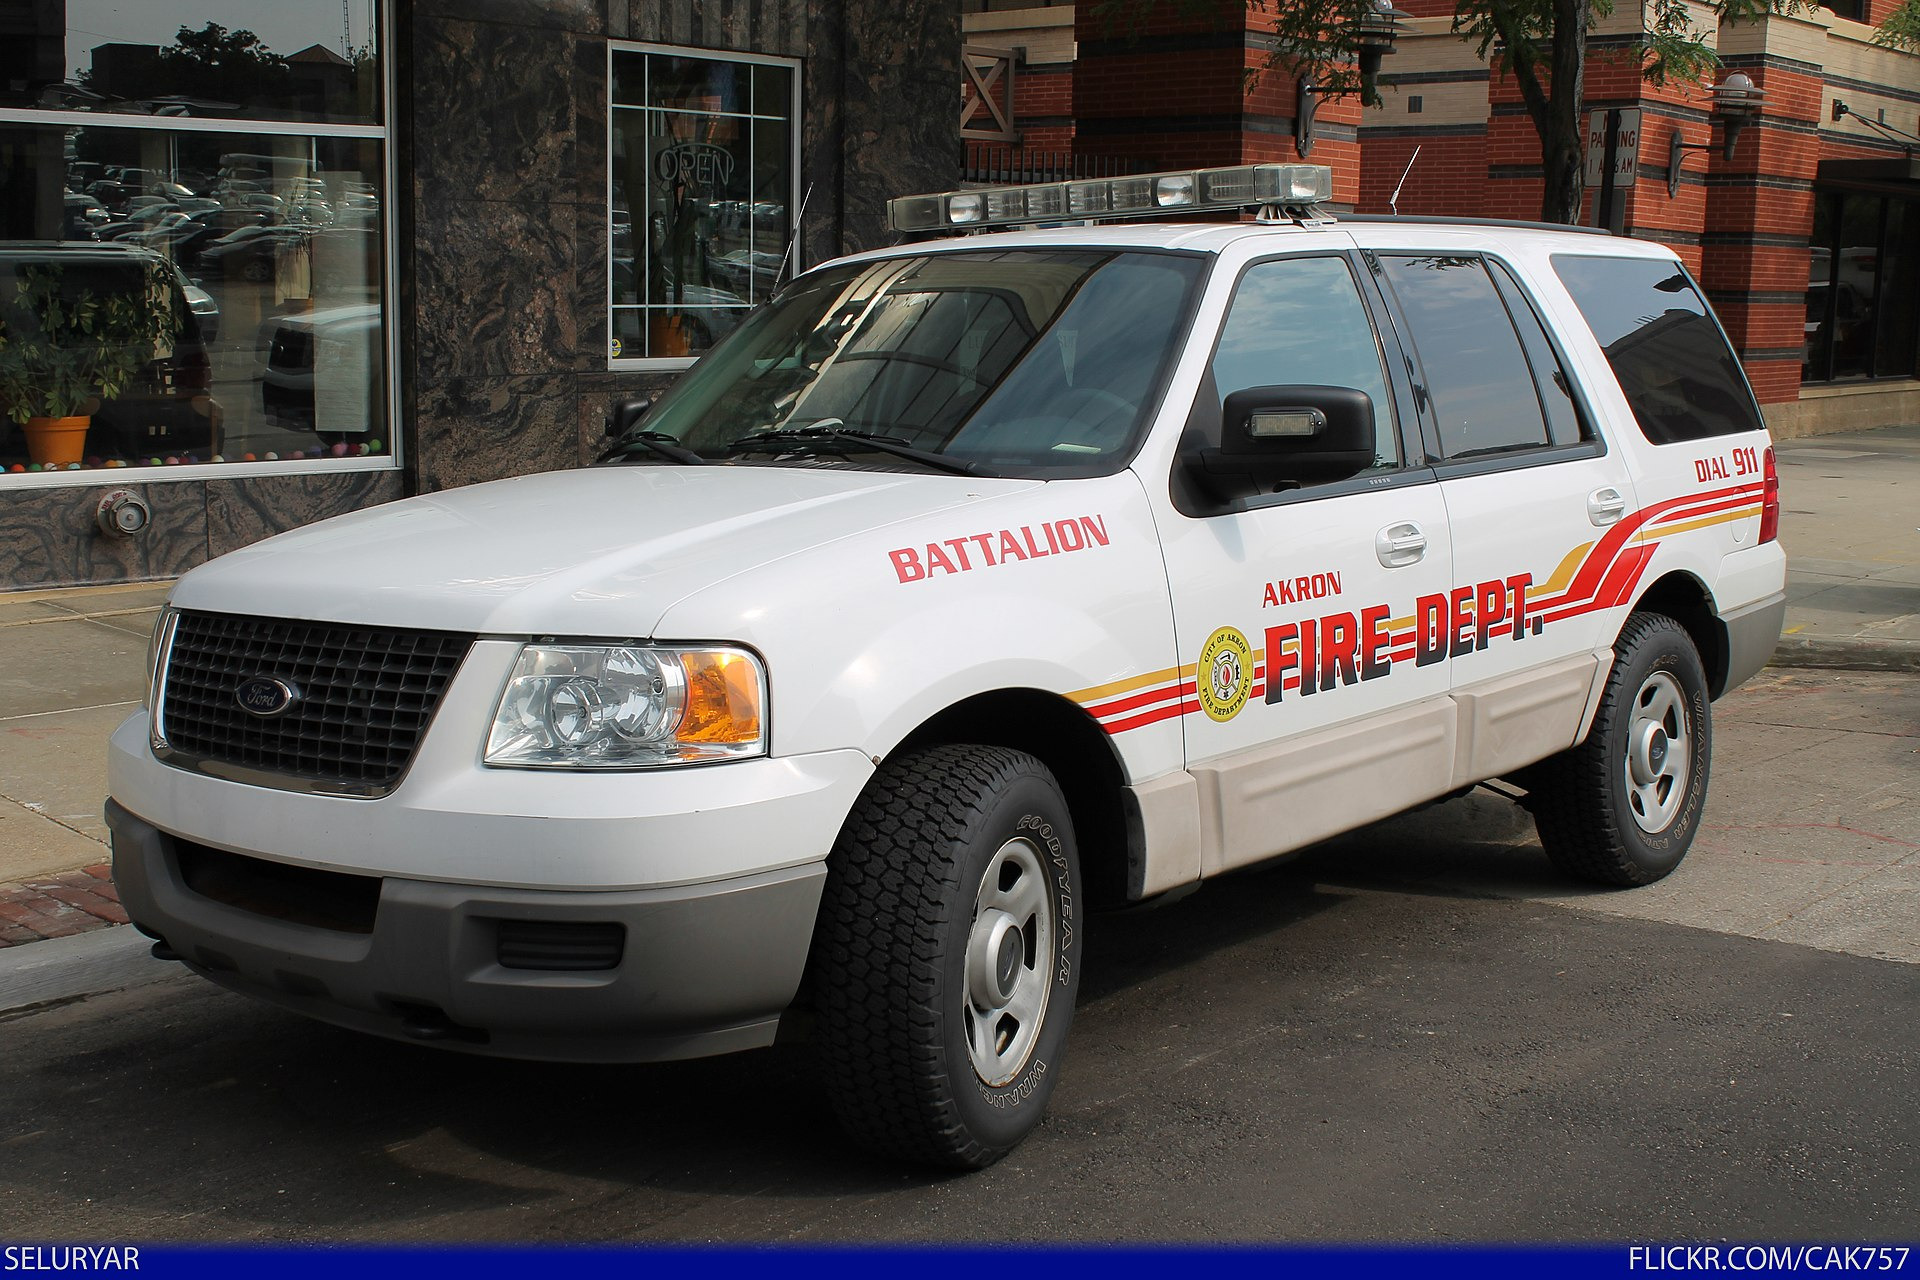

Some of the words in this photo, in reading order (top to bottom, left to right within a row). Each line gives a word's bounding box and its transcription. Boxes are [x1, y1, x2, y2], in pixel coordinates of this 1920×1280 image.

[1590, 130, 1635, 148] PAING
[660, 149, 730, 186] OPEN
[1620, 158, 1633, 174] AM
[1694, 456, 1731, 483] DIAL
[1732, 446, 1759, 476] 911
[888, 513, 1111, 585] BATTALION
[1262, 570, 1343, 609] AKRON
[1204, 641, 1216, 662] CITY
[1216, 633, 1226, 644] OF
[1226, 633, 1247, 654] AKRON
[1264, 603, 1393, 706] FIRE
[1415, 572, 1544, 668] DEPT.
[247, 683, 278, 708] Ford
[1202, 687, 1214, 709] FIRE
[1213, 676, 1249, 715] DEPARTMENT
[1674, 690, 1705, 840] WRANGLER
[1016, 815, 1072, 986] GOODYEAR
[975, 1059, 1047, 1109] WRANG
